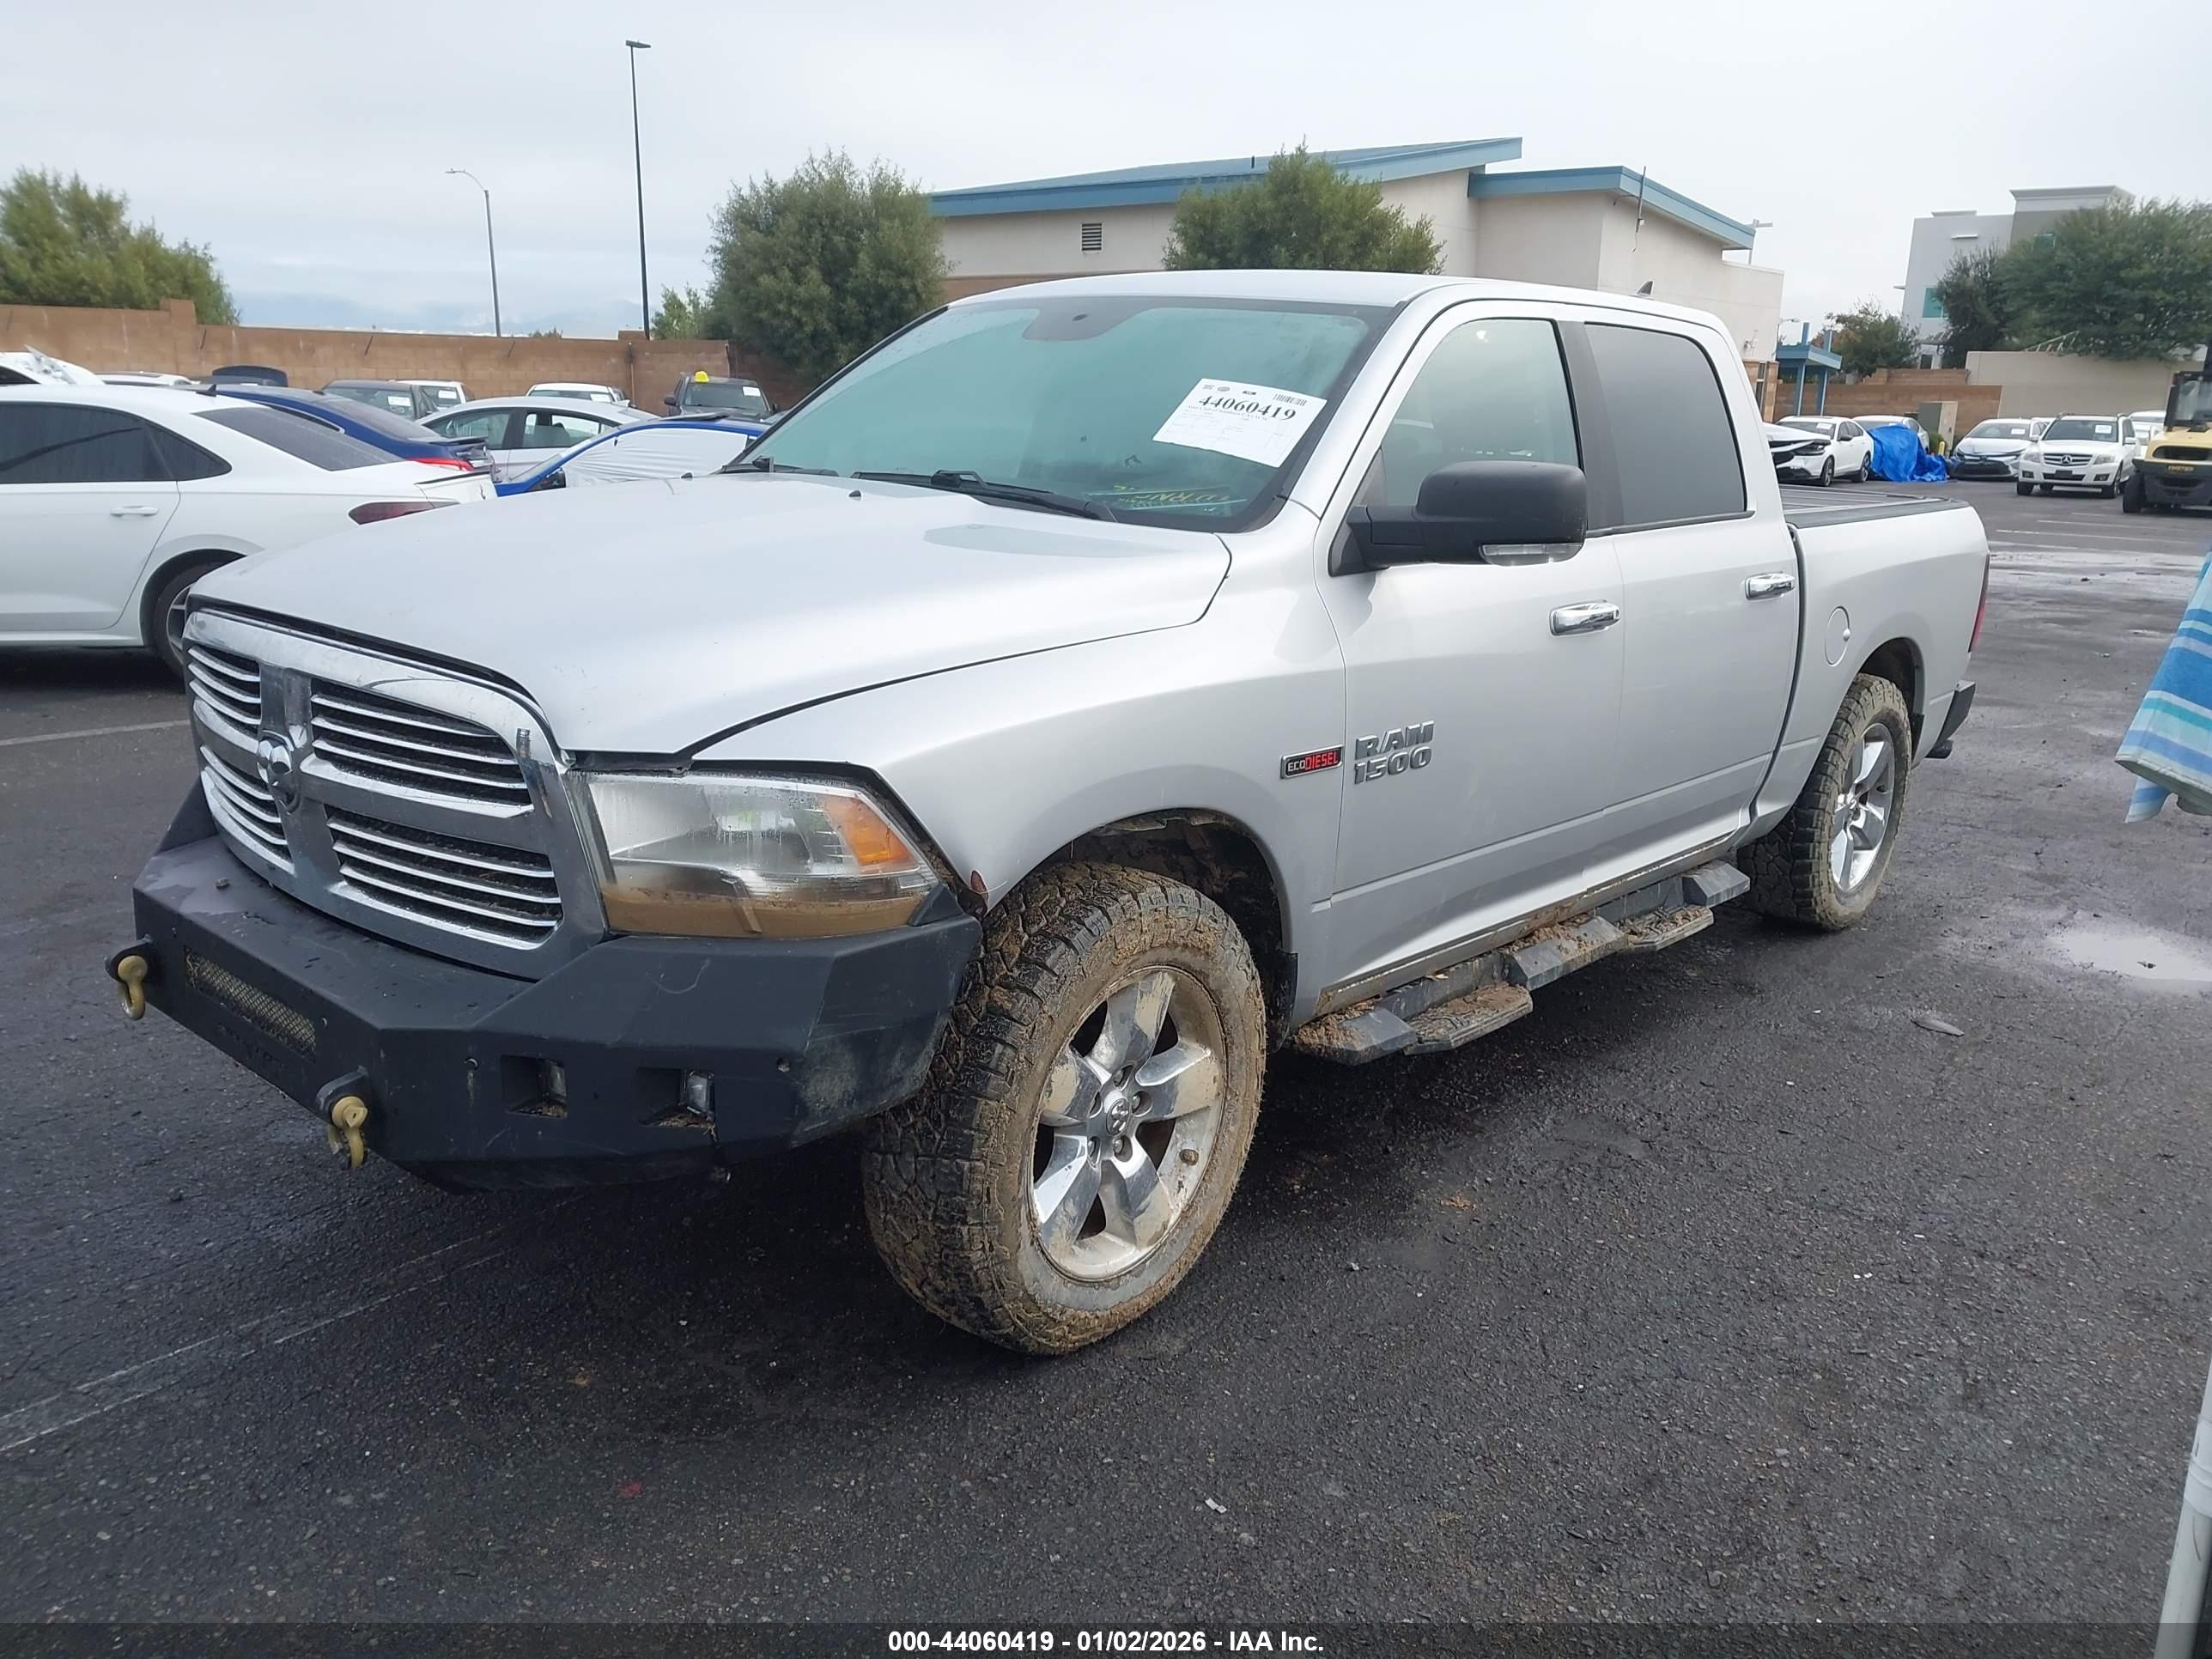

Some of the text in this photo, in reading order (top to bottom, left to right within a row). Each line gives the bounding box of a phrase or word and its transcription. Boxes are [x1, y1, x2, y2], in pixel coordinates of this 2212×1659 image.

[1199, 396, 1297, 420] 44060419
[1355, 720, 1435, 760] RAM
[1354, 746, 1431, 785] 1500
